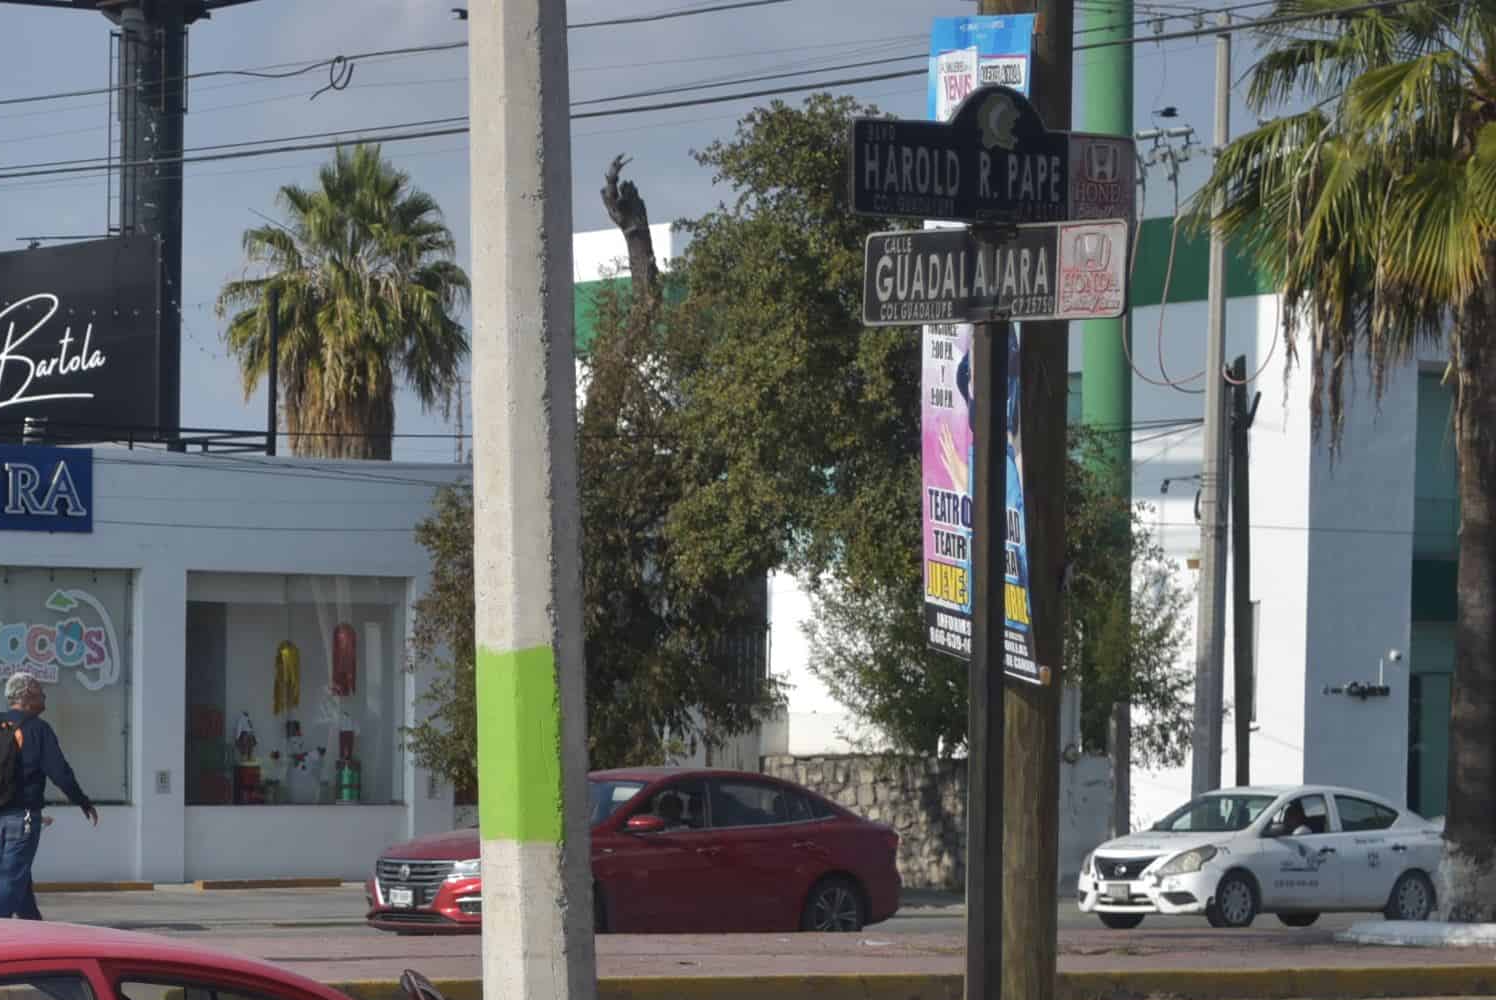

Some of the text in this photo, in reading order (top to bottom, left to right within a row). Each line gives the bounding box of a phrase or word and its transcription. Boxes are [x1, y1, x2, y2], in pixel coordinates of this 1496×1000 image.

[864, 143, 1062, 203] HAROLD R. PAPE
[883, 237, 913, 254] CALLE
[875, 246, 1049, 303] GUADALAJARA
[900, 301, 954, 320] GUADALUPE
[934, 529, 971, 561] TEATR
